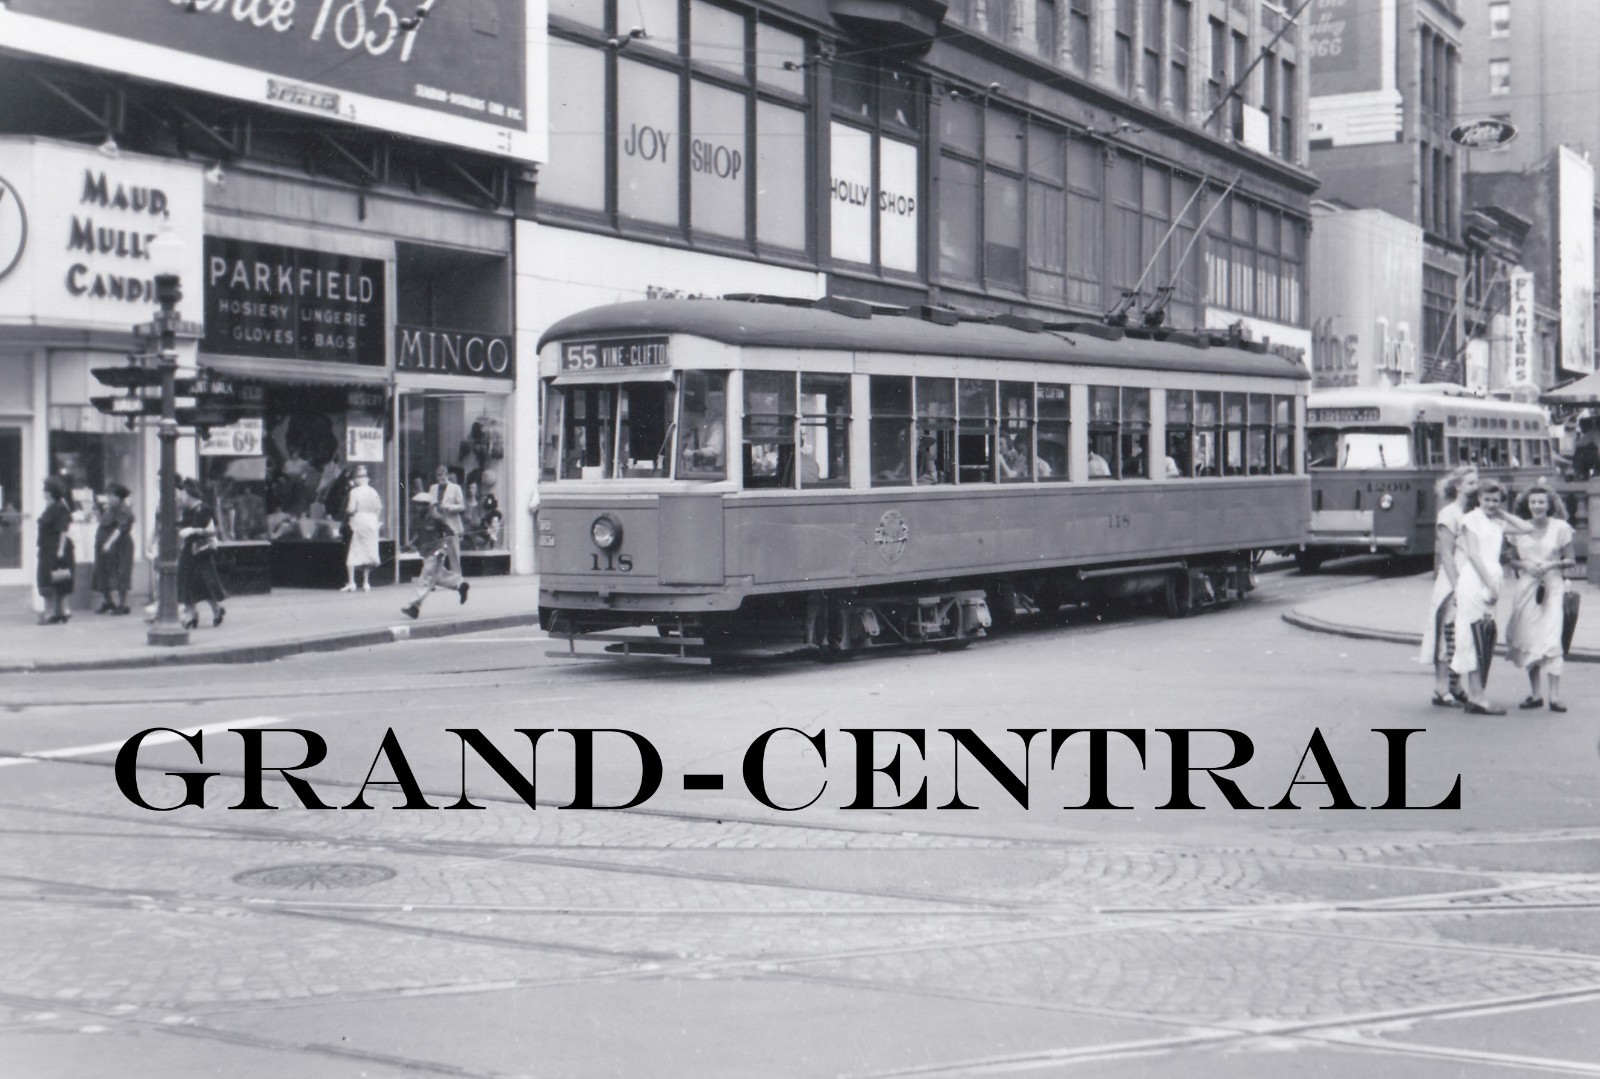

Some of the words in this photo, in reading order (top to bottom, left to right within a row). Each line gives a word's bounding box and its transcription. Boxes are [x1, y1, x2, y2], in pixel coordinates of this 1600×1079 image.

[624, 124, 670, 163] JOY
[692, 139, 741, 180] SHOP
[831, 176, 870, 208] HOLLY
[879, 190, 915, 217] SHOP
[210, 256, 373, 303] PARKFIELD
[219, 299, 289, 320] HOSIERY
[301, 308, 367, 327] LINGERIE
[1515, 278, 1528, 382] PLANTERS
[232, 325, 295, 345] GLOVES
[314, 333, 357, 350] BAGS
[398, 329, 509, 373] MINCO
[567, 344, 598, 370] 55
[602, 345, 625, 367] VINE
[1106, 513, 1131, 529] 118
[590, 552, 634, 573] 118
